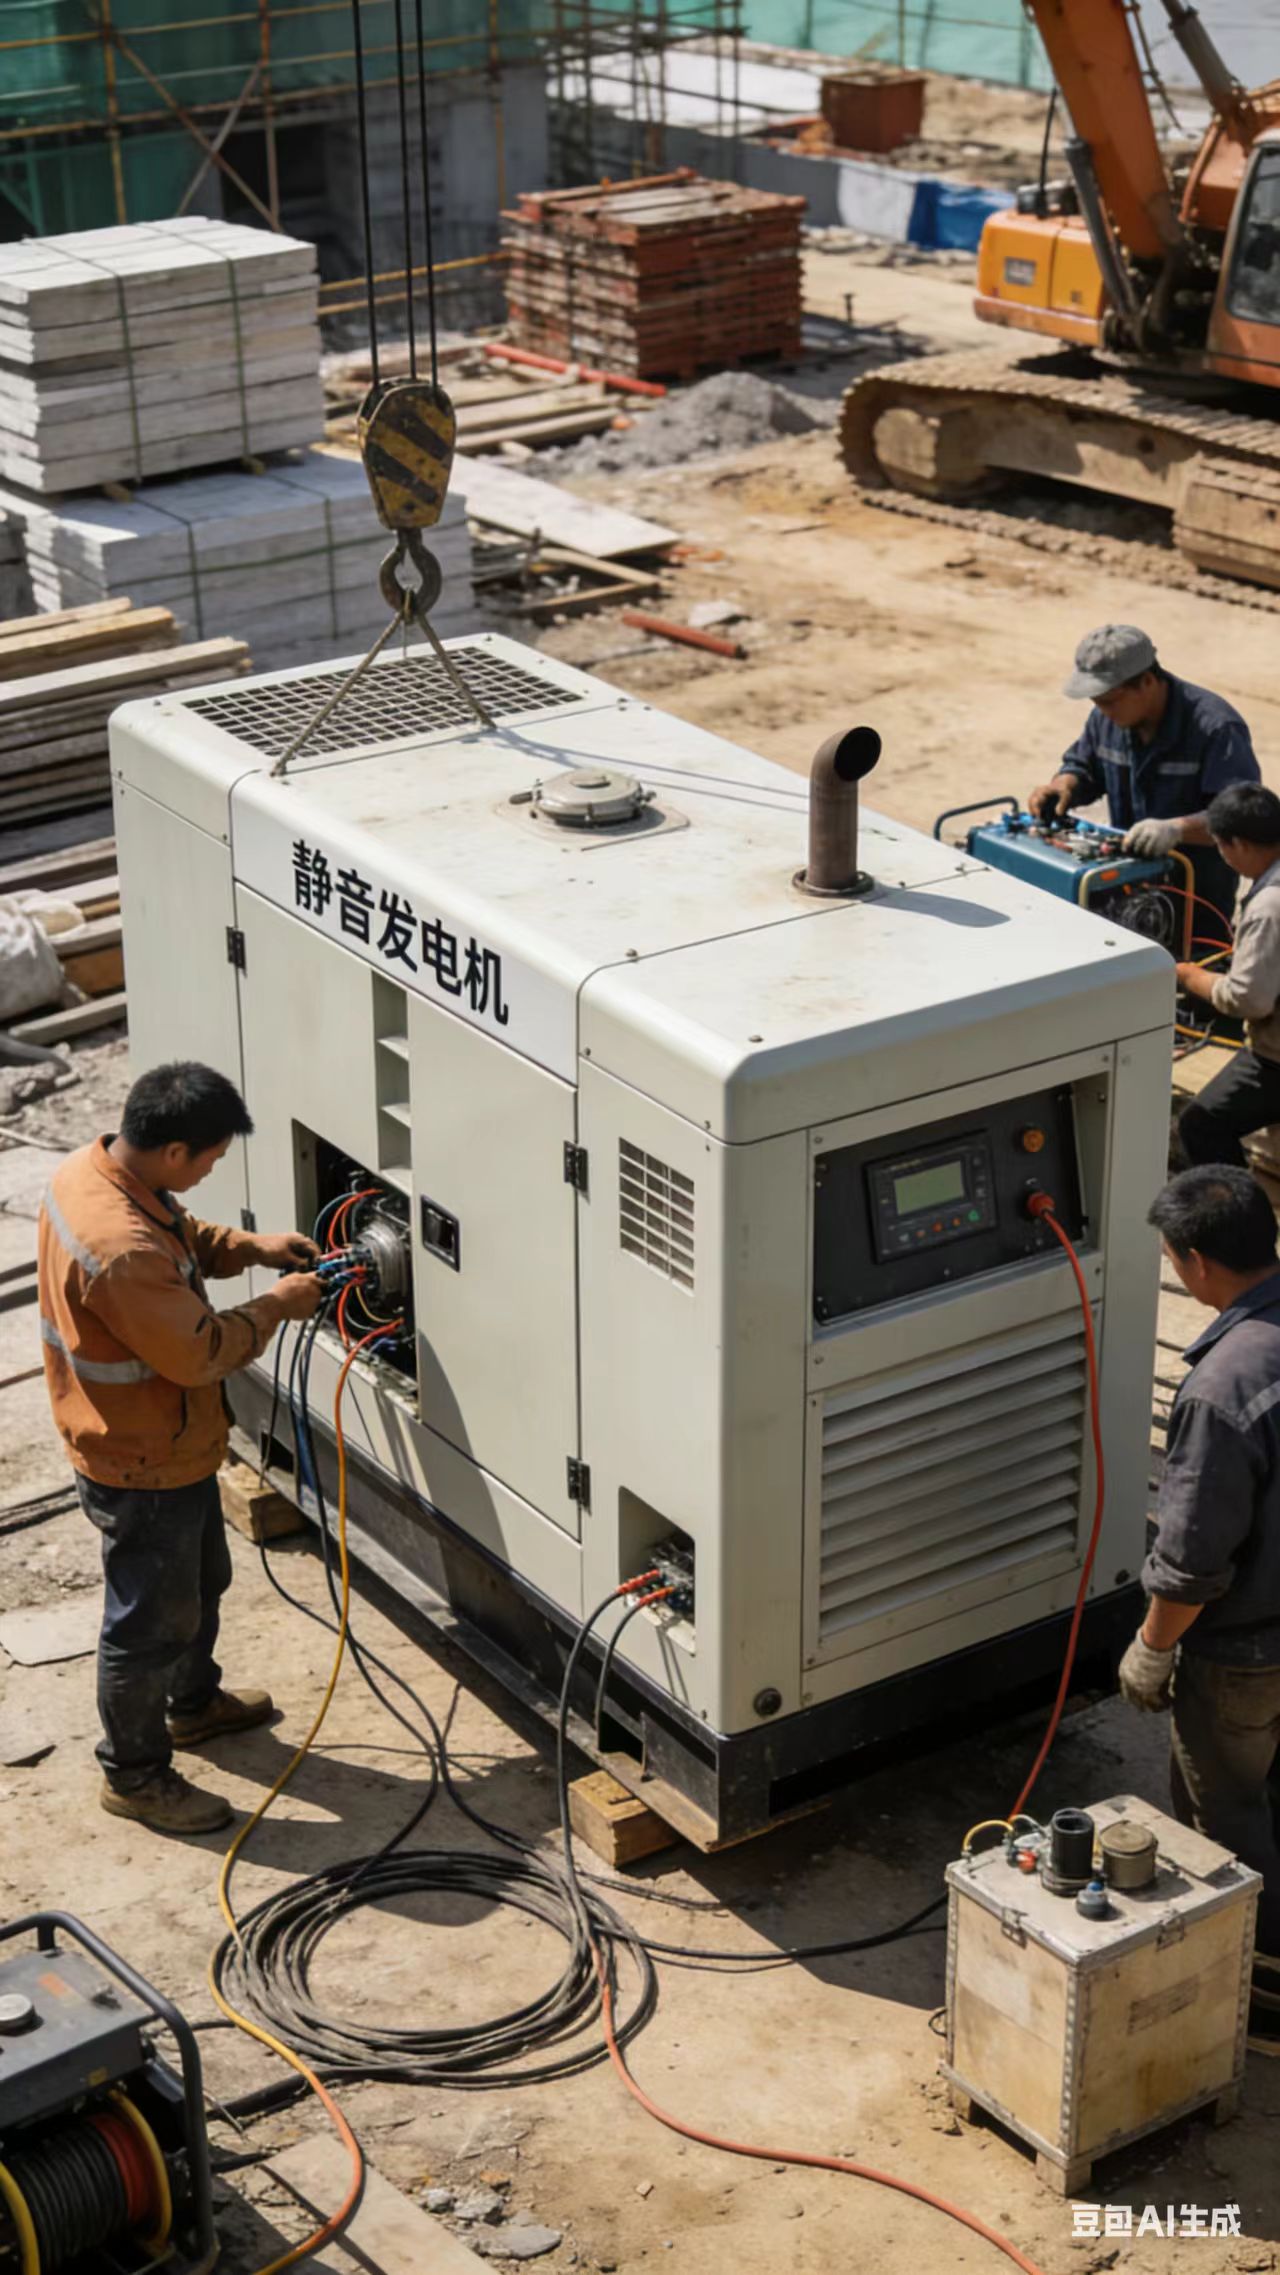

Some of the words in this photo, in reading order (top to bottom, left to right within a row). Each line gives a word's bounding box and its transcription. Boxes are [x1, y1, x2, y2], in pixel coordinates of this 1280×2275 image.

[292, 839, 509, 1026] 静音发电机
